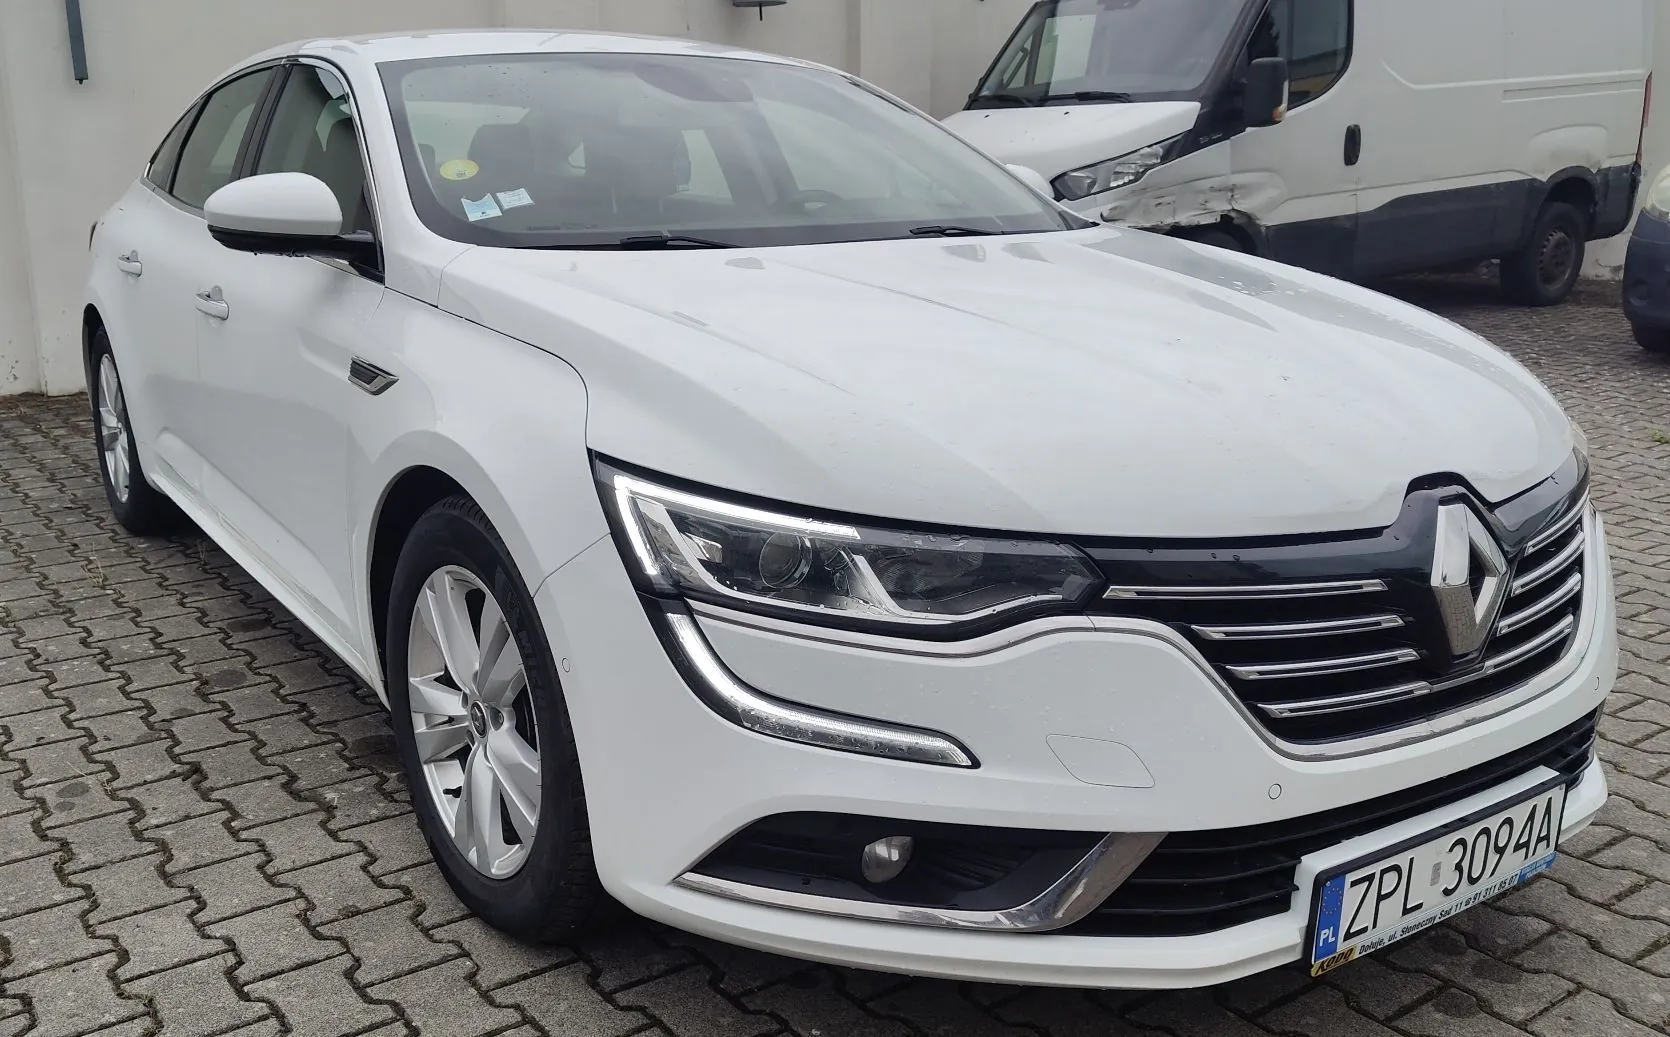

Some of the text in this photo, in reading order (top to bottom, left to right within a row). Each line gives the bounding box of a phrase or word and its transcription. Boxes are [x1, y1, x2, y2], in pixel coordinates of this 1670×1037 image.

[1342, 796, 1552, 942] ZPL 3094A
[1320, 926, 1336, 947] PL
